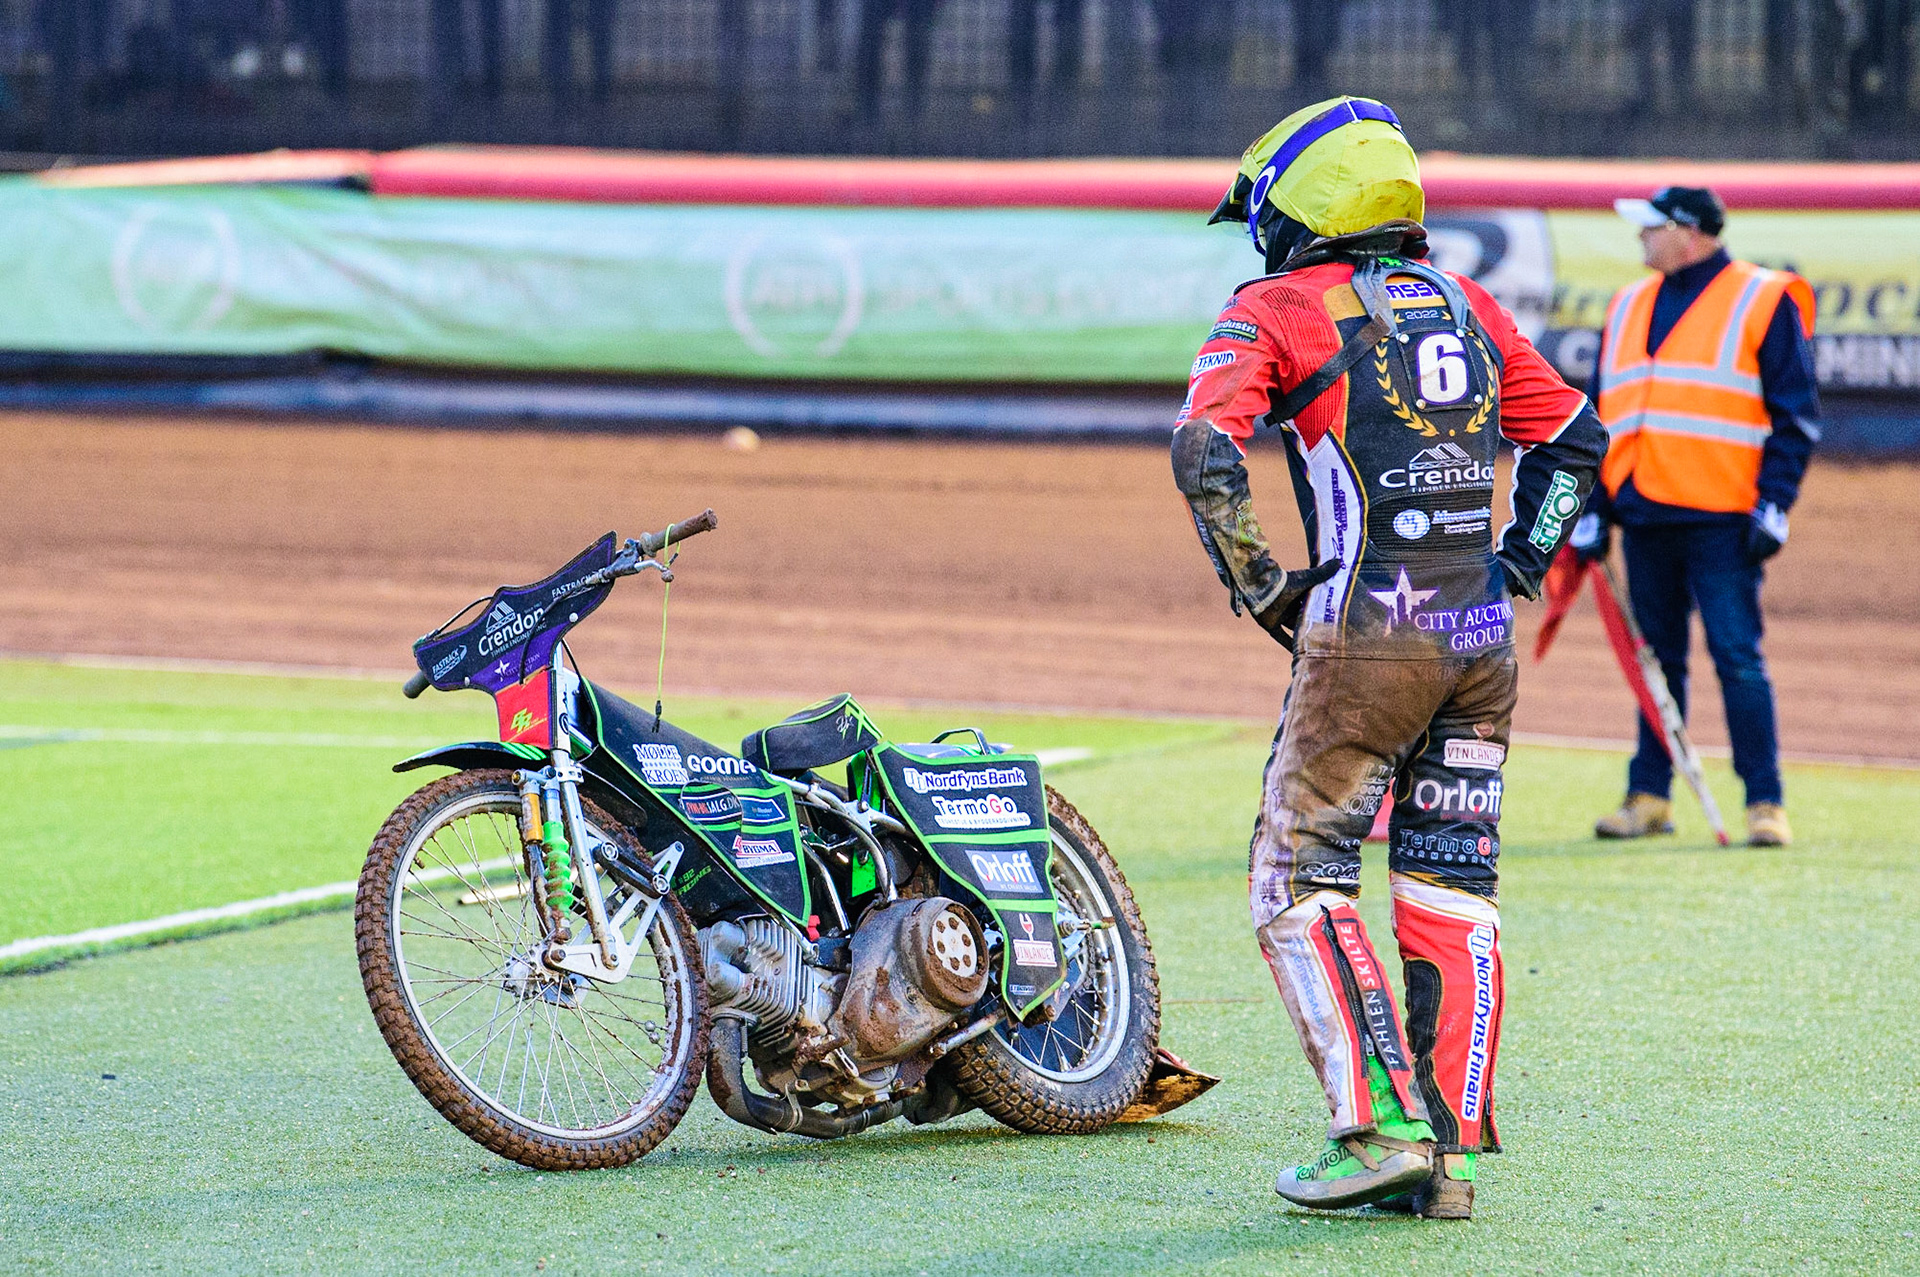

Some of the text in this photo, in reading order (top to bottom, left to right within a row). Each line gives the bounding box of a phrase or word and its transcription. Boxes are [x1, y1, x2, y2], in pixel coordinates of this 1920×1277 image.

[1405, 310, 1439, 320] 2022
[1417, 332, 1469, 404] 6
[1379, 461, 1494, 488] Crendo
[1535, 474, 1578, 551] SCHOU
[478, 607, 546, 657] Crendon
[1414, 611, 1460, 630] CITY
[1451, 625, 1505, 650] GROUP
[432, 648, 460, 674] FASTRACK
[644, 769, 689, 783] KROEN
[935, 798, 1013, 815] TermoGo
[1415, 779, 1502, 813] Orloff
[1400, 829, 1499, 857] TermoGo
[971, 852, 1035, 883] Orloff
[1340, 925, 1376, 987] SKILTE
[1464, 955, 1491, 1119] Nordfyns Finans
